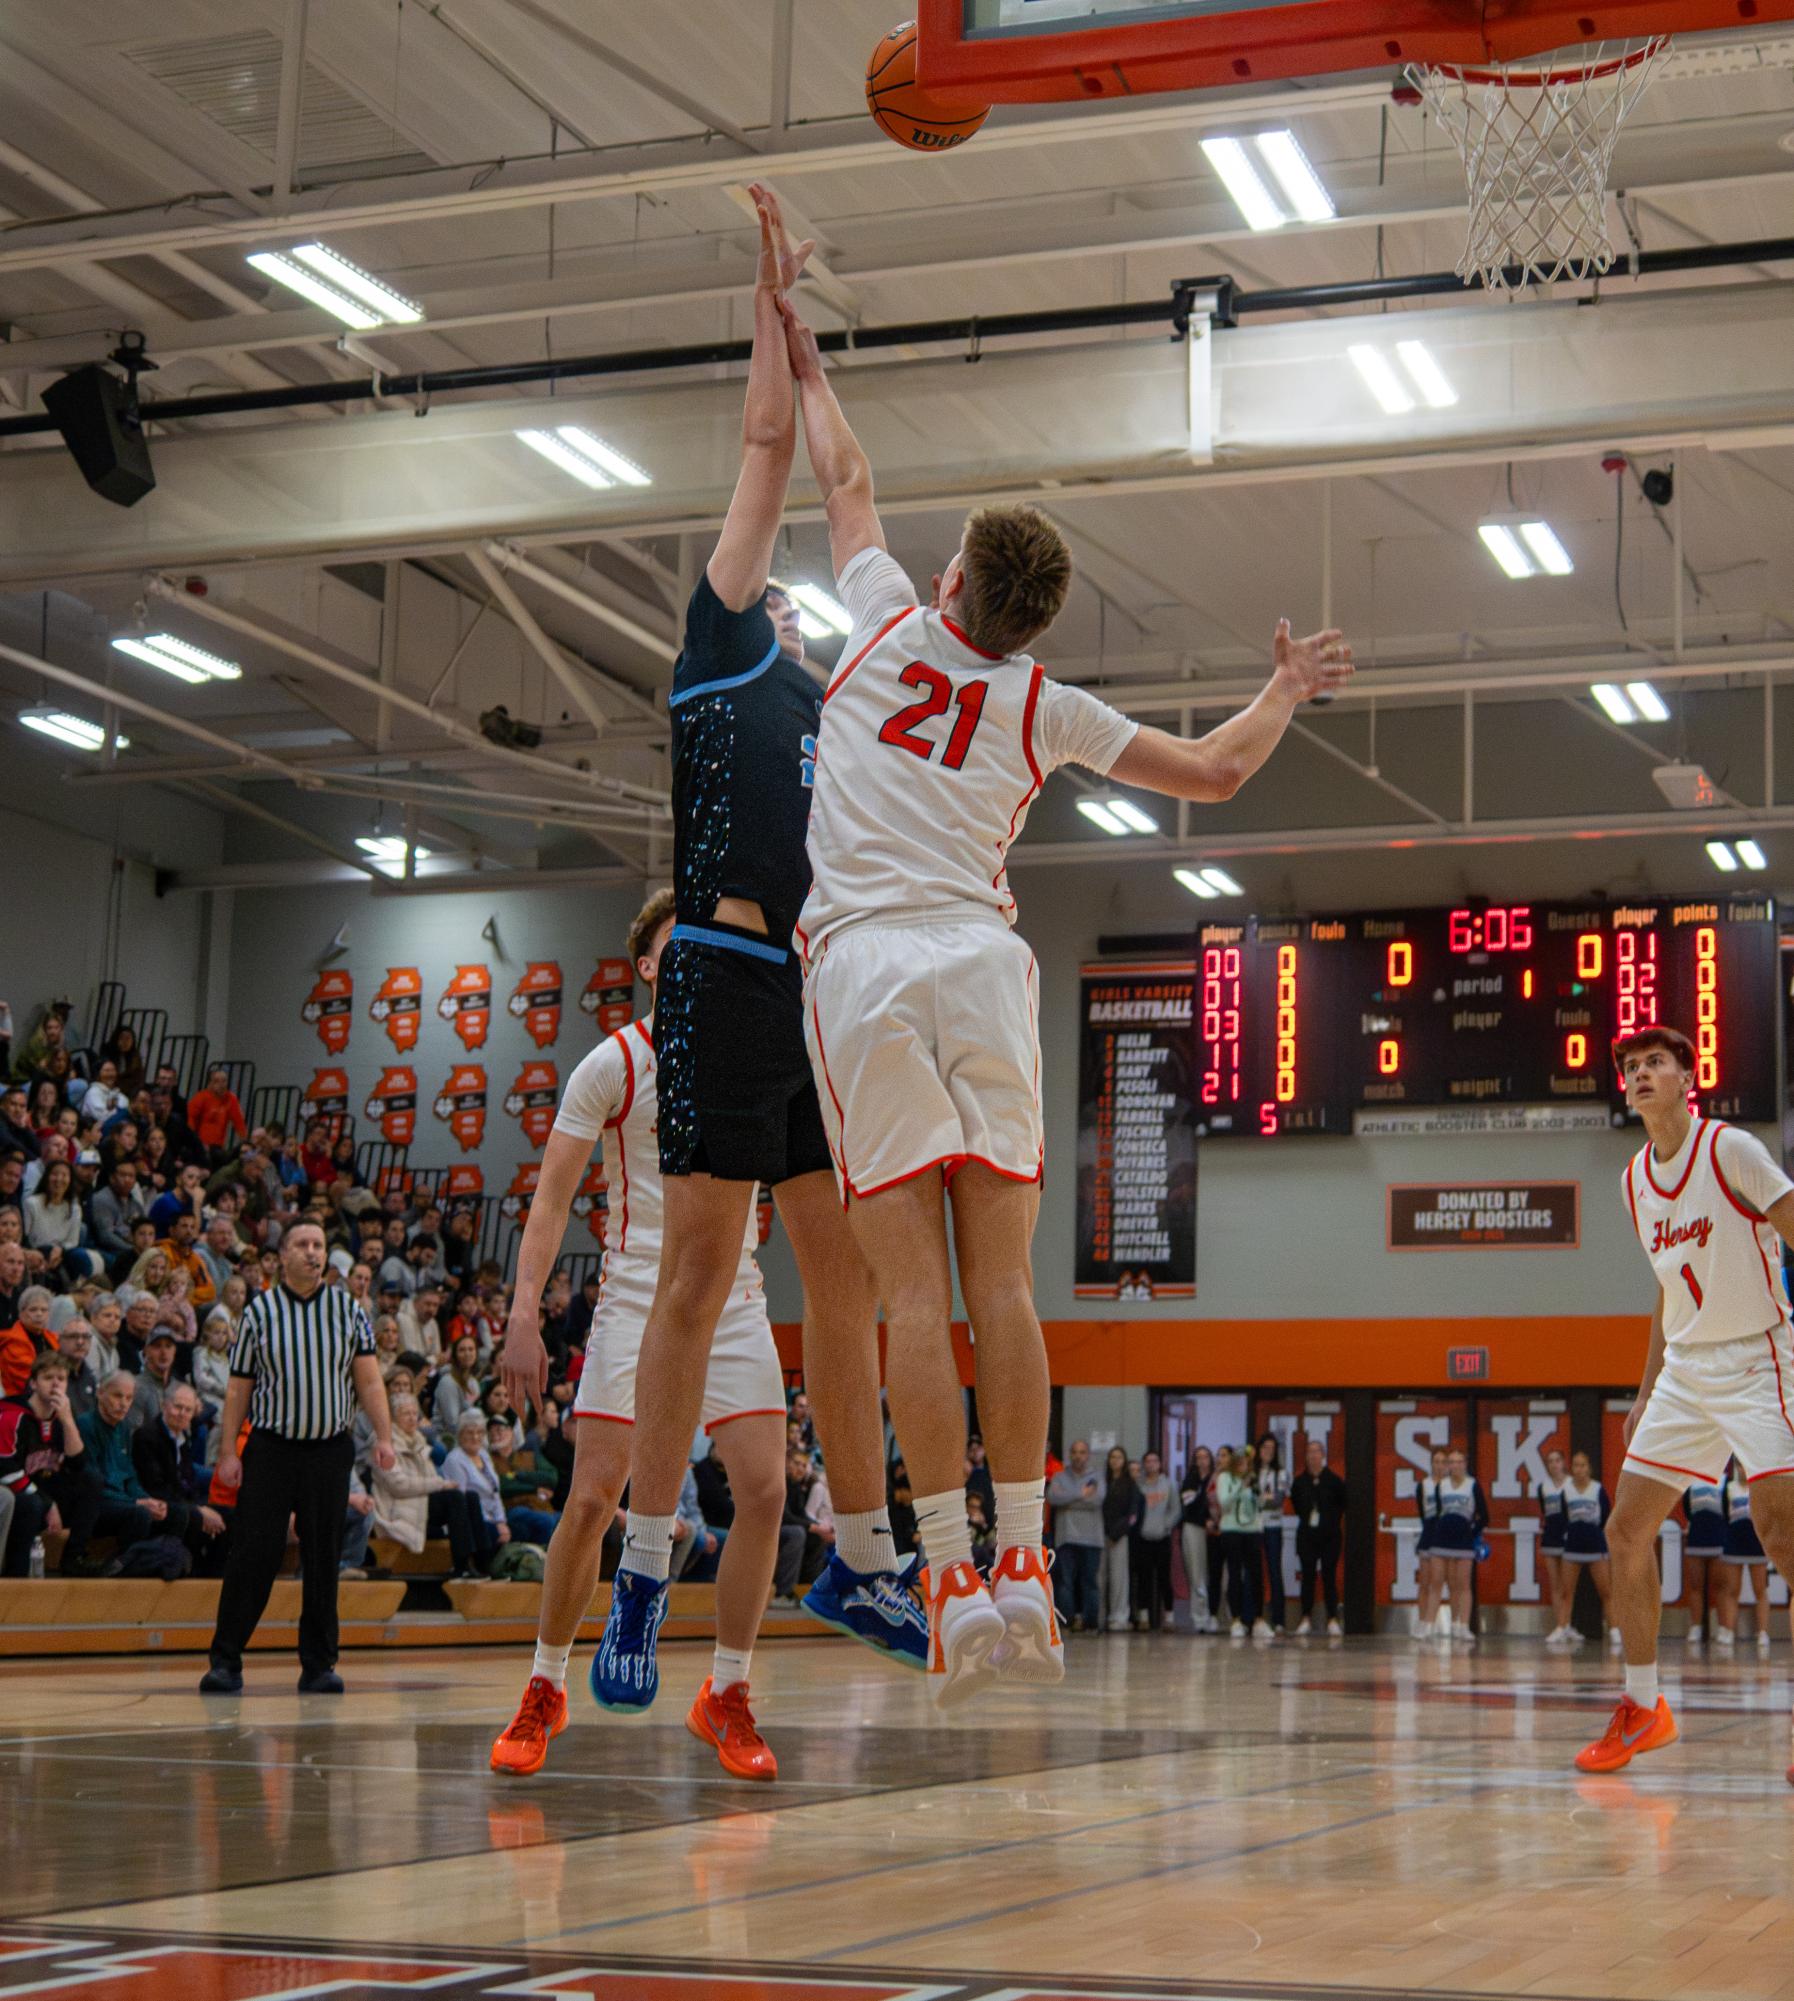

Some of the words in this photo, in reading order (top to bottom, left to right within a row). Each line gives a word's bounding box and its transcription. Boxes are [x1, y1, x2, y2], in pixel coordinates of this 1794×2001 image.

[879, 660, 988, 770] 21
[1450, 908, 1532, 952] 6:06
[1613, 905, 1657, 929] player
[1674, 904, 1718, 926] points
[1578, 935, 1602, 978] 0
[1618, 933, 1656, 962] 01
[1388, 943, 1412, 986] 0
[1618, 963, 1656, 994] 02
[1134, 984, 1193, 999] VARSITY
[1454, 975, 1502, 997] period
[1523, 970, 1533, 998] 1
[1089, 999, 1193, 1021] BASKETBALL
[1454, 1011, 1502, 1031] player
[1618, 996, 1656, 1026] 04
[1380, 1040, 1399, 1074] 0
[1567, 1034, 1587, 1068] 0
[1260, 1103, 1278, 1135] 5
[1362, 1121, 1420, 1134] ATHLETIC
[1425, 1119, 1487, 1131] BOOSTER
[1493, 1118, 1527, 1130] CLUB
[1438, 1192, 1504, 1211] DONATED
[1509, 1191, 1529, 1209] BY
[1415, 1211, 1470, 1231] HERSEY
[1474, 1210, 1553, 1229] BOOSTERS
[1650, 1216, 1713, 1253] Hersey
[1680, 1263, 1703, 1311] 1
[1455, 1353, 1480, 1376] EXIT
